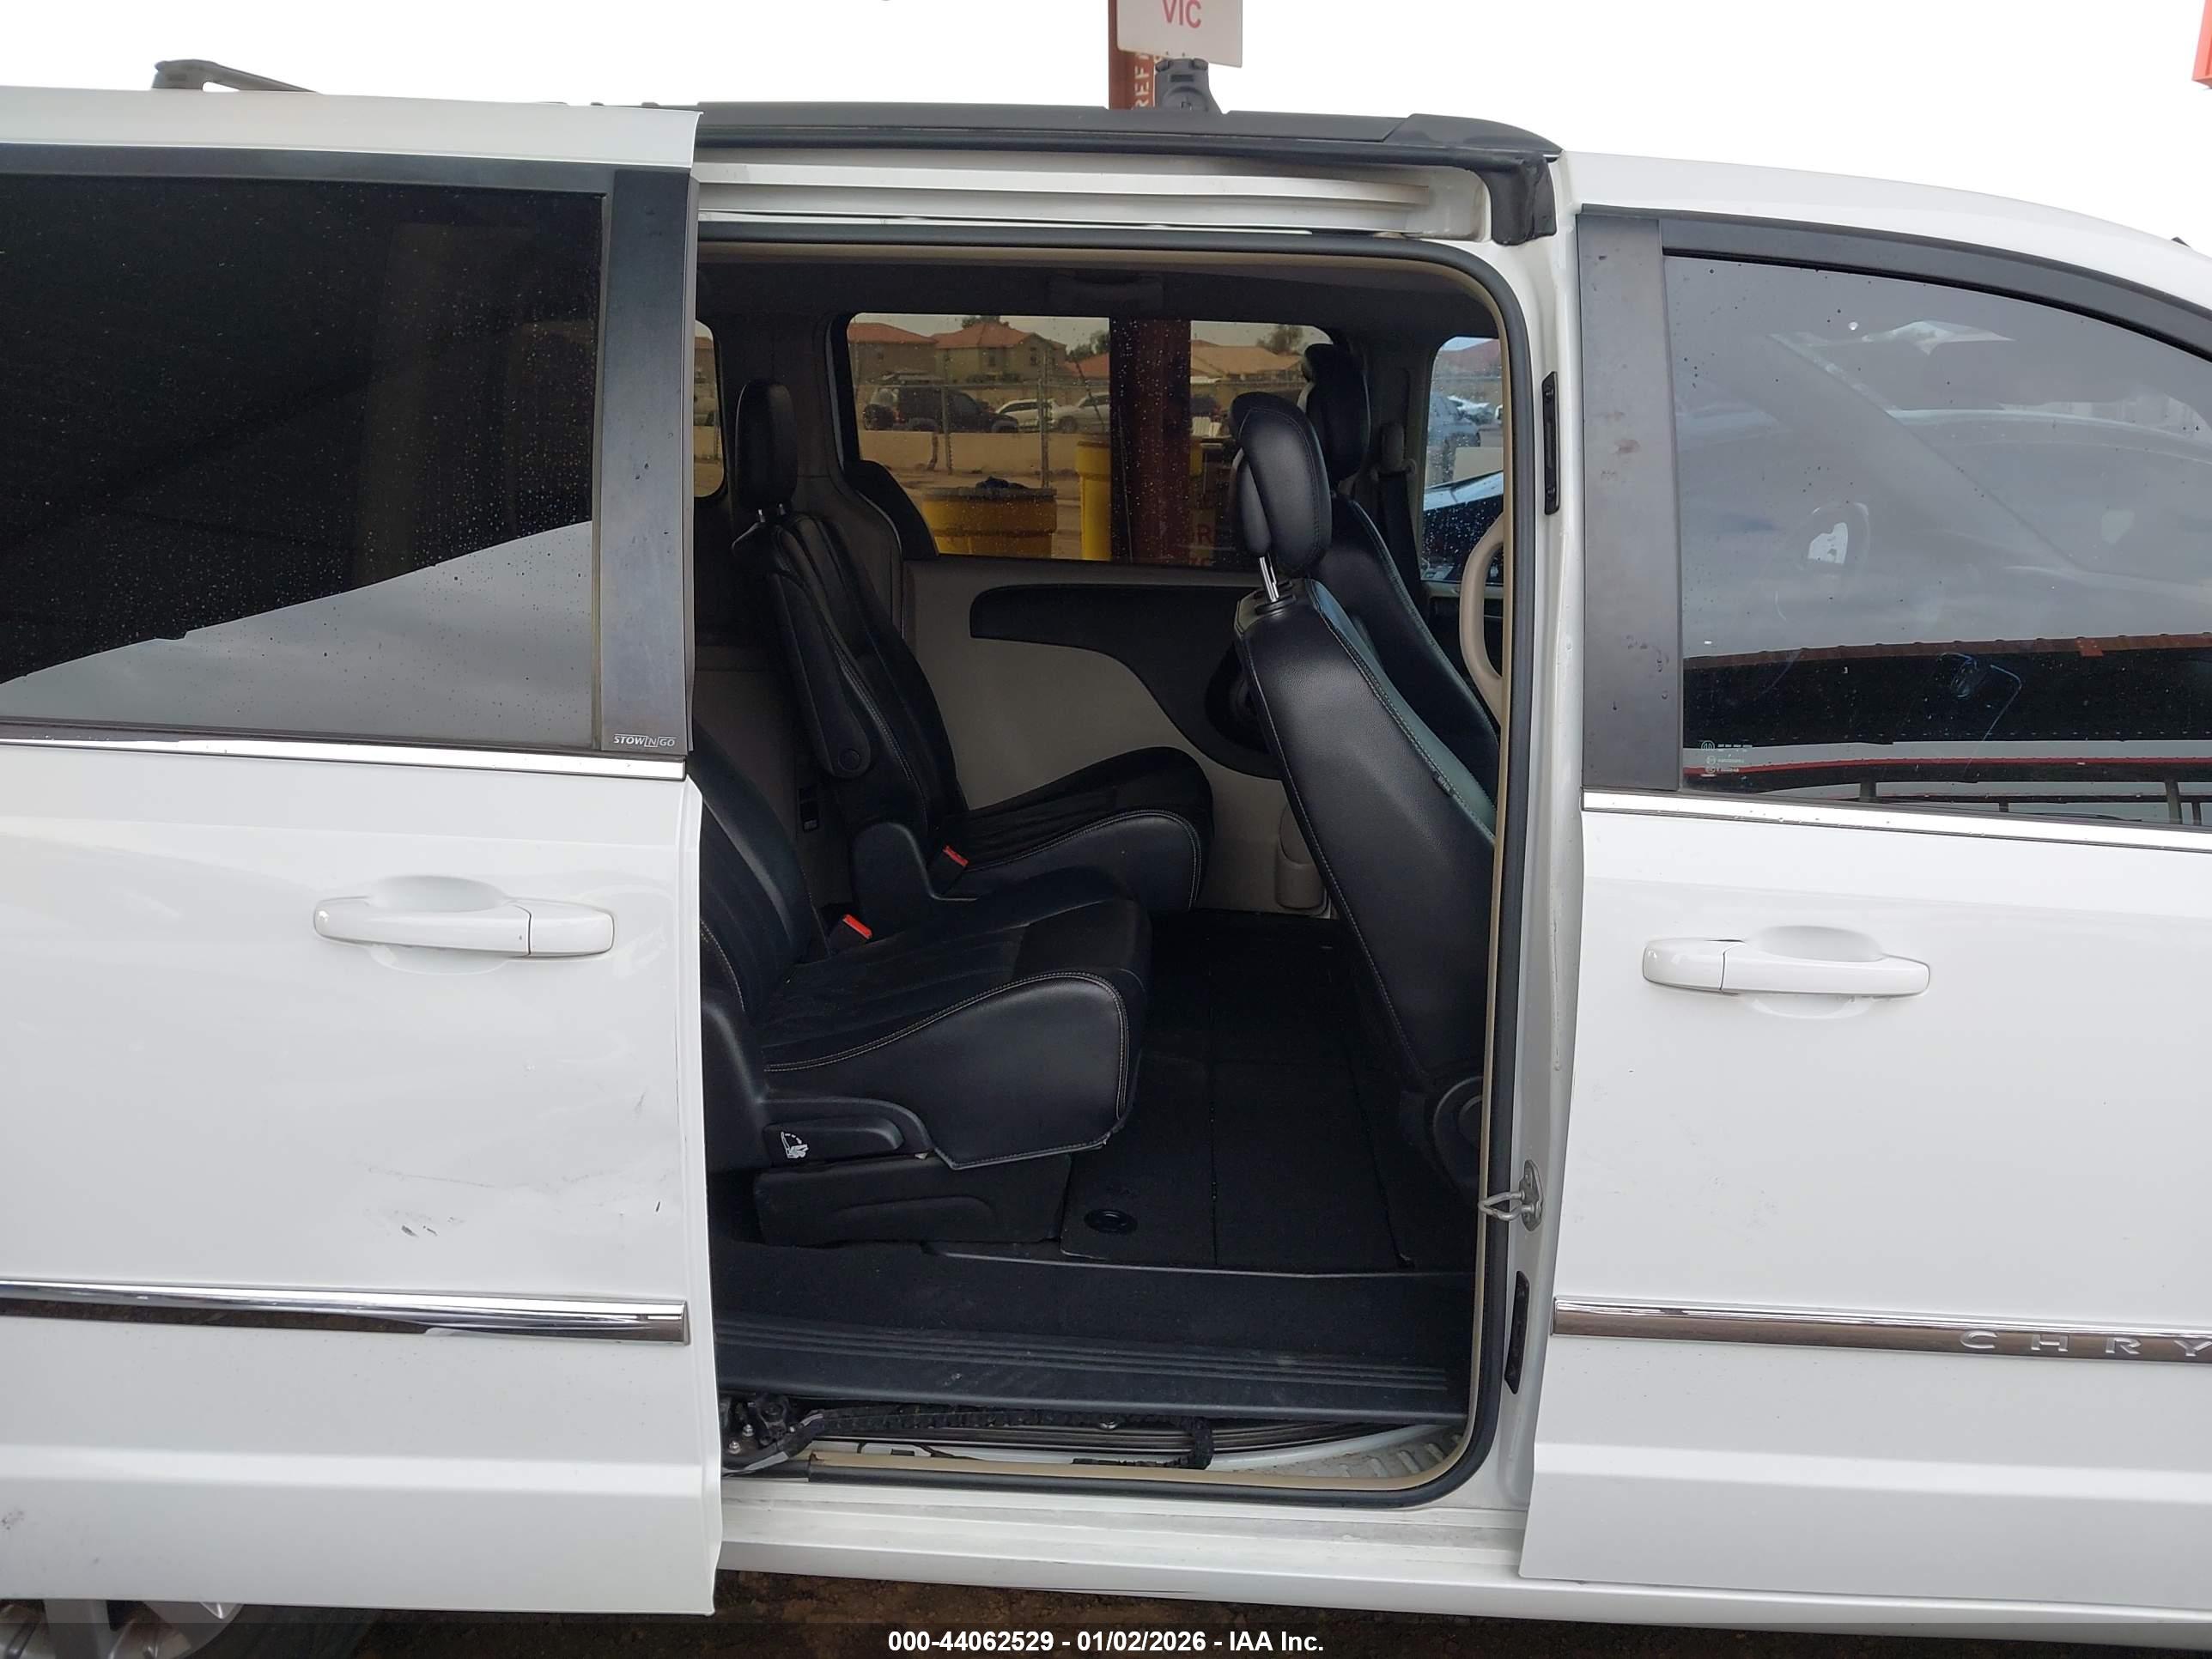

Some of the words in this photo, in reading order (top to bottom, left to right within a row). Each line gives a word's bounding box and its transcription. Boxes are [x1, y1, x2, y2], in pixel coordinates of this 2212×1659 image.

[1162, 0, 1201, 28] VIC
[613, 735, 645, 745] STOW
[659, 738, 675, 747] GO
[1960, 1330, 2212, 1357] CHRY
